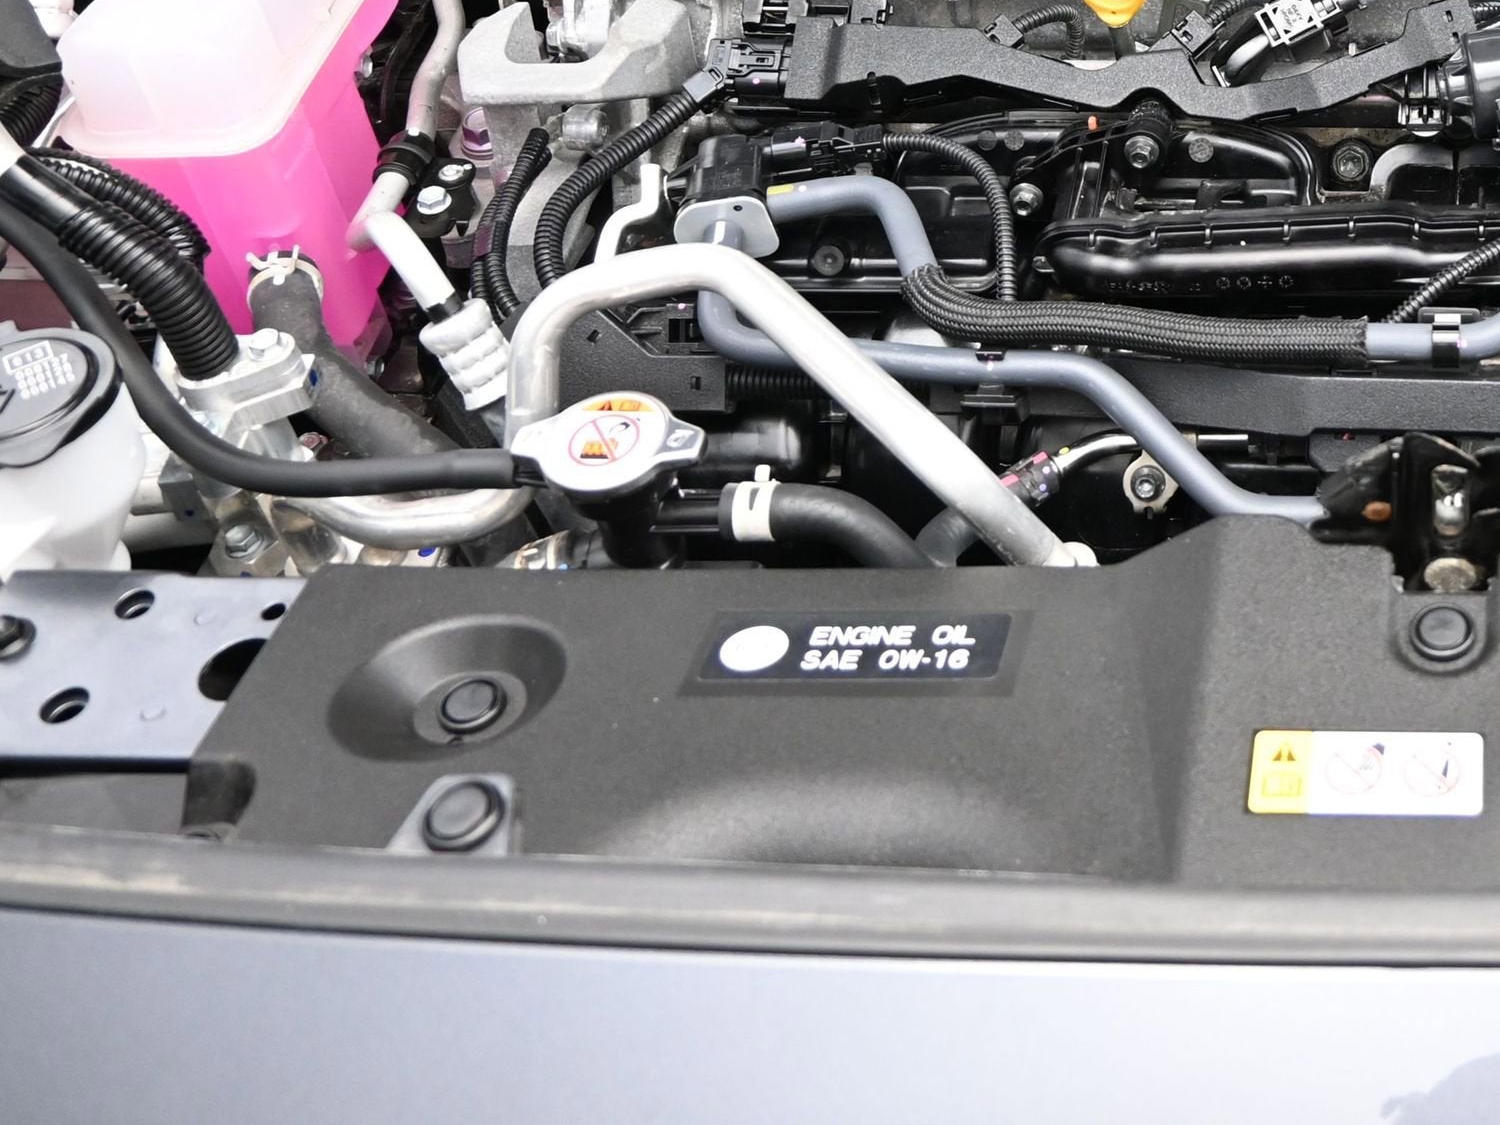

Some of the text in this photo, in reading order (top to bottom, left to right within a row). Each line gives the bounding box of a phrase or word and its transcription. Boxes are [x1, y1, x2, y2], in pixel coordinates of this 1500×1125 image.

[808, 625, 976, 646] ENGINE OIL
[800, 649, 970, 671] SAE 0W-16
